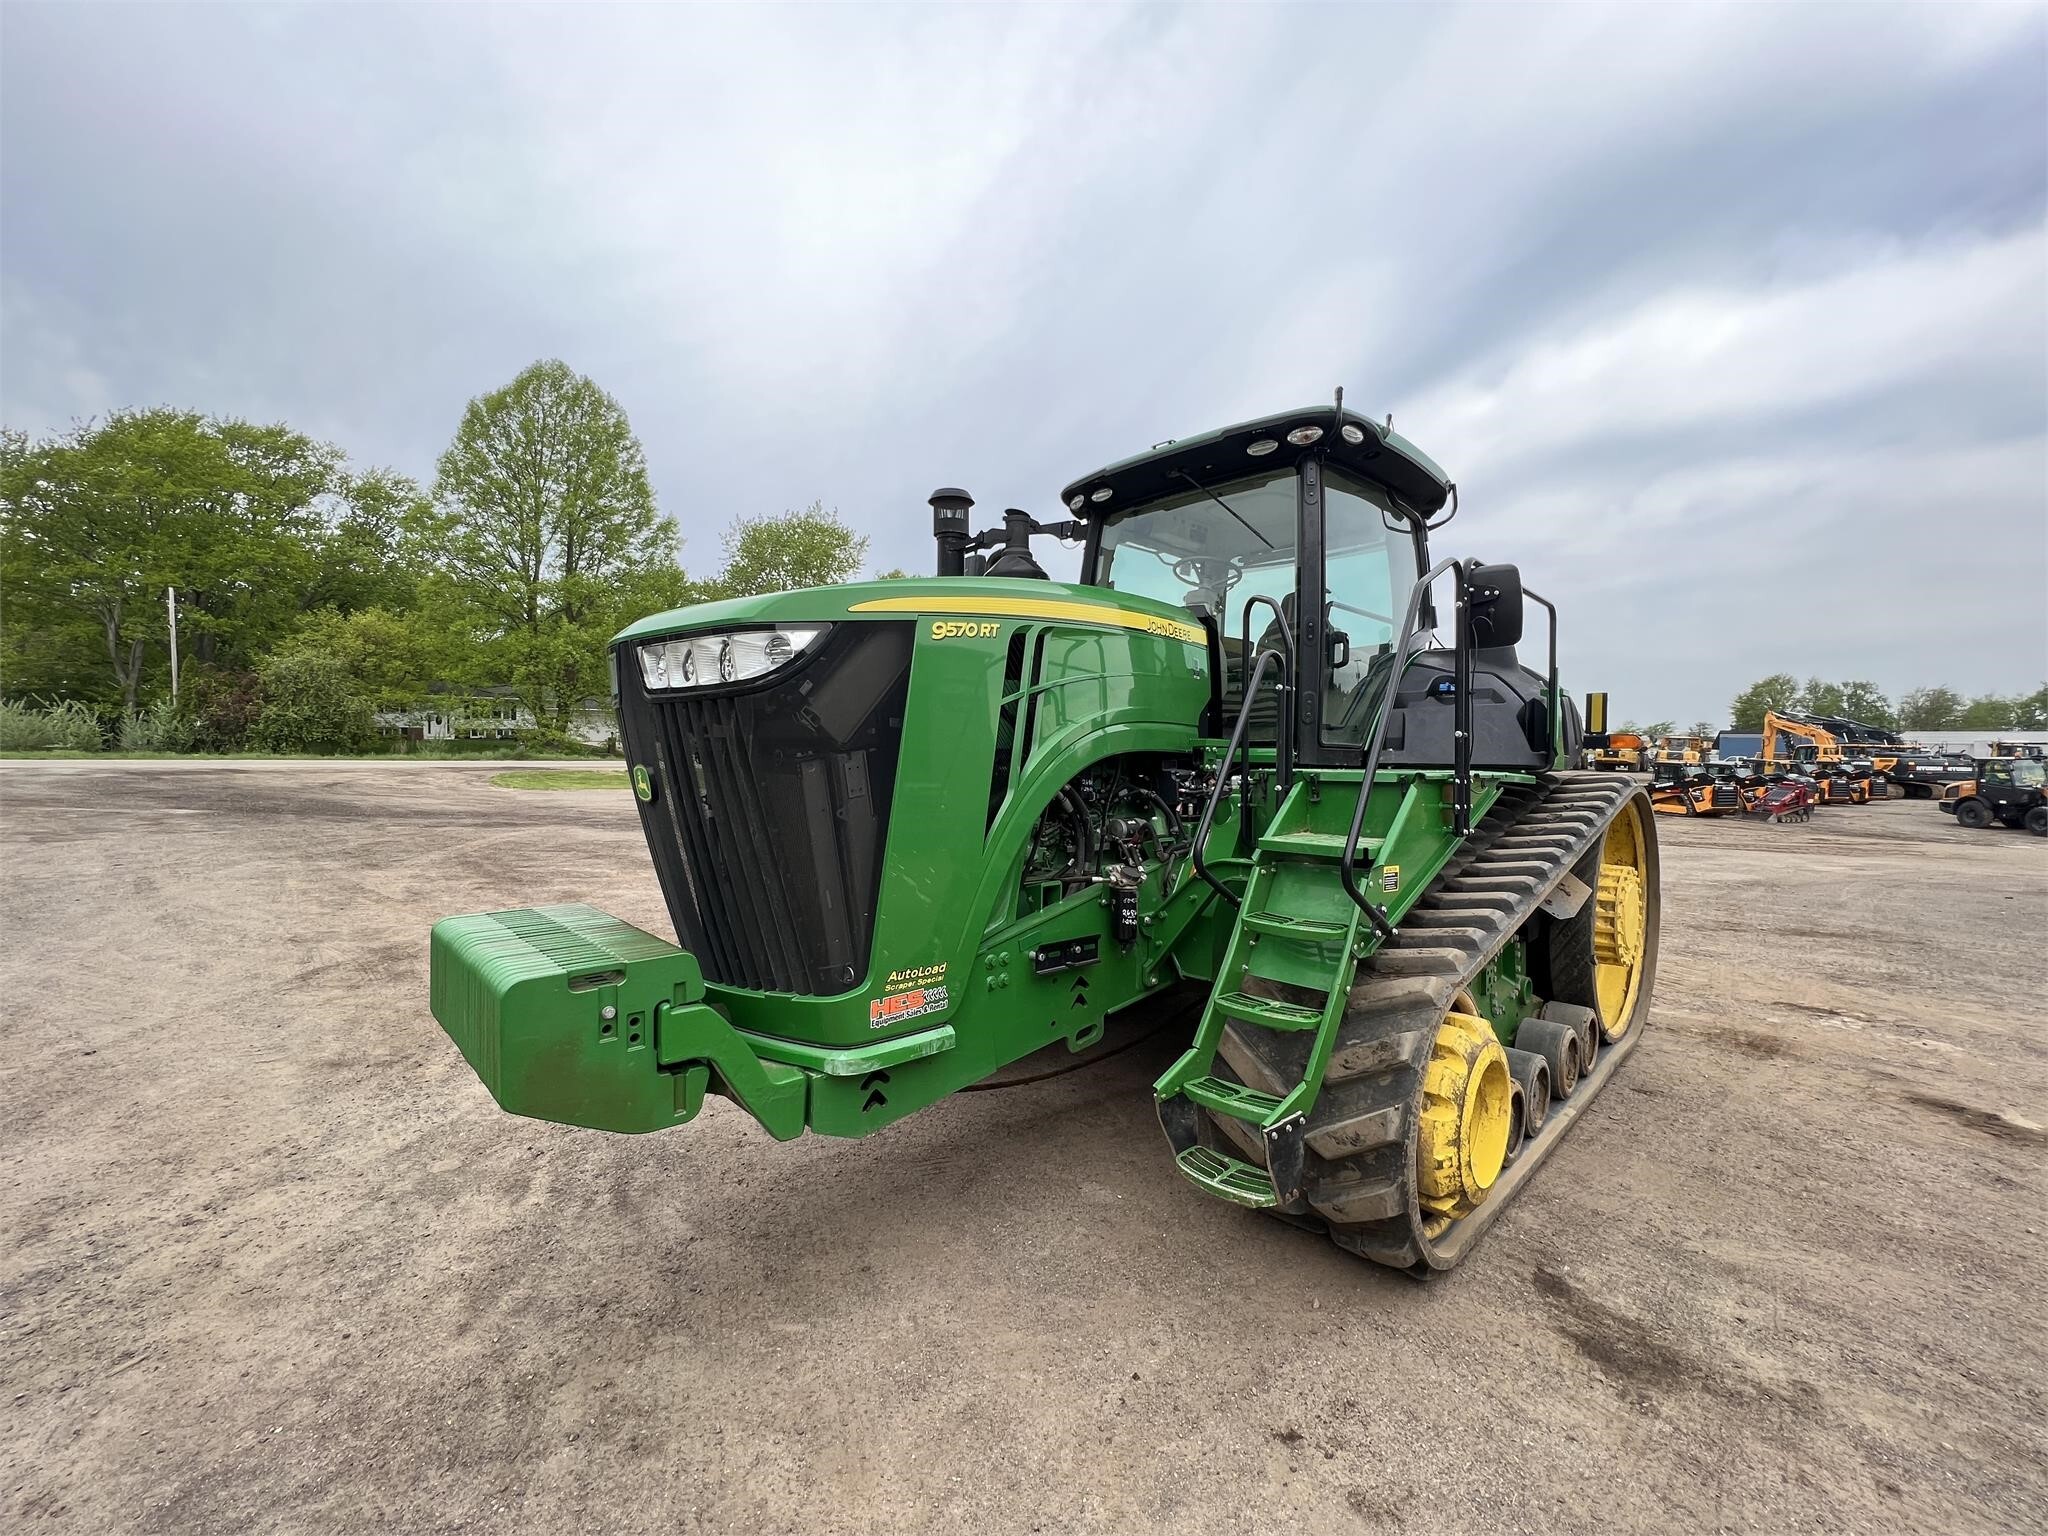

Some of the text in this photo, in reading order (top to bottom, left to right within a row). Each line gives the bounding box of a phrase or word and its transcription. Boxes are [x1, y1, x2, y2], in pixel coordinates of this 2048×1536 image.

[932, 622, 1001, 640] 9570 RT
[1146, 618, 1192, 641] JOHN DEERE
[886, 962, 947, 982] AutoLoad
[885, 975, 945, 991] Scraper Special
[870, 989, 925, 1019] HES
[871, 1000, 948, 1027] Equipment Sales & Rental
